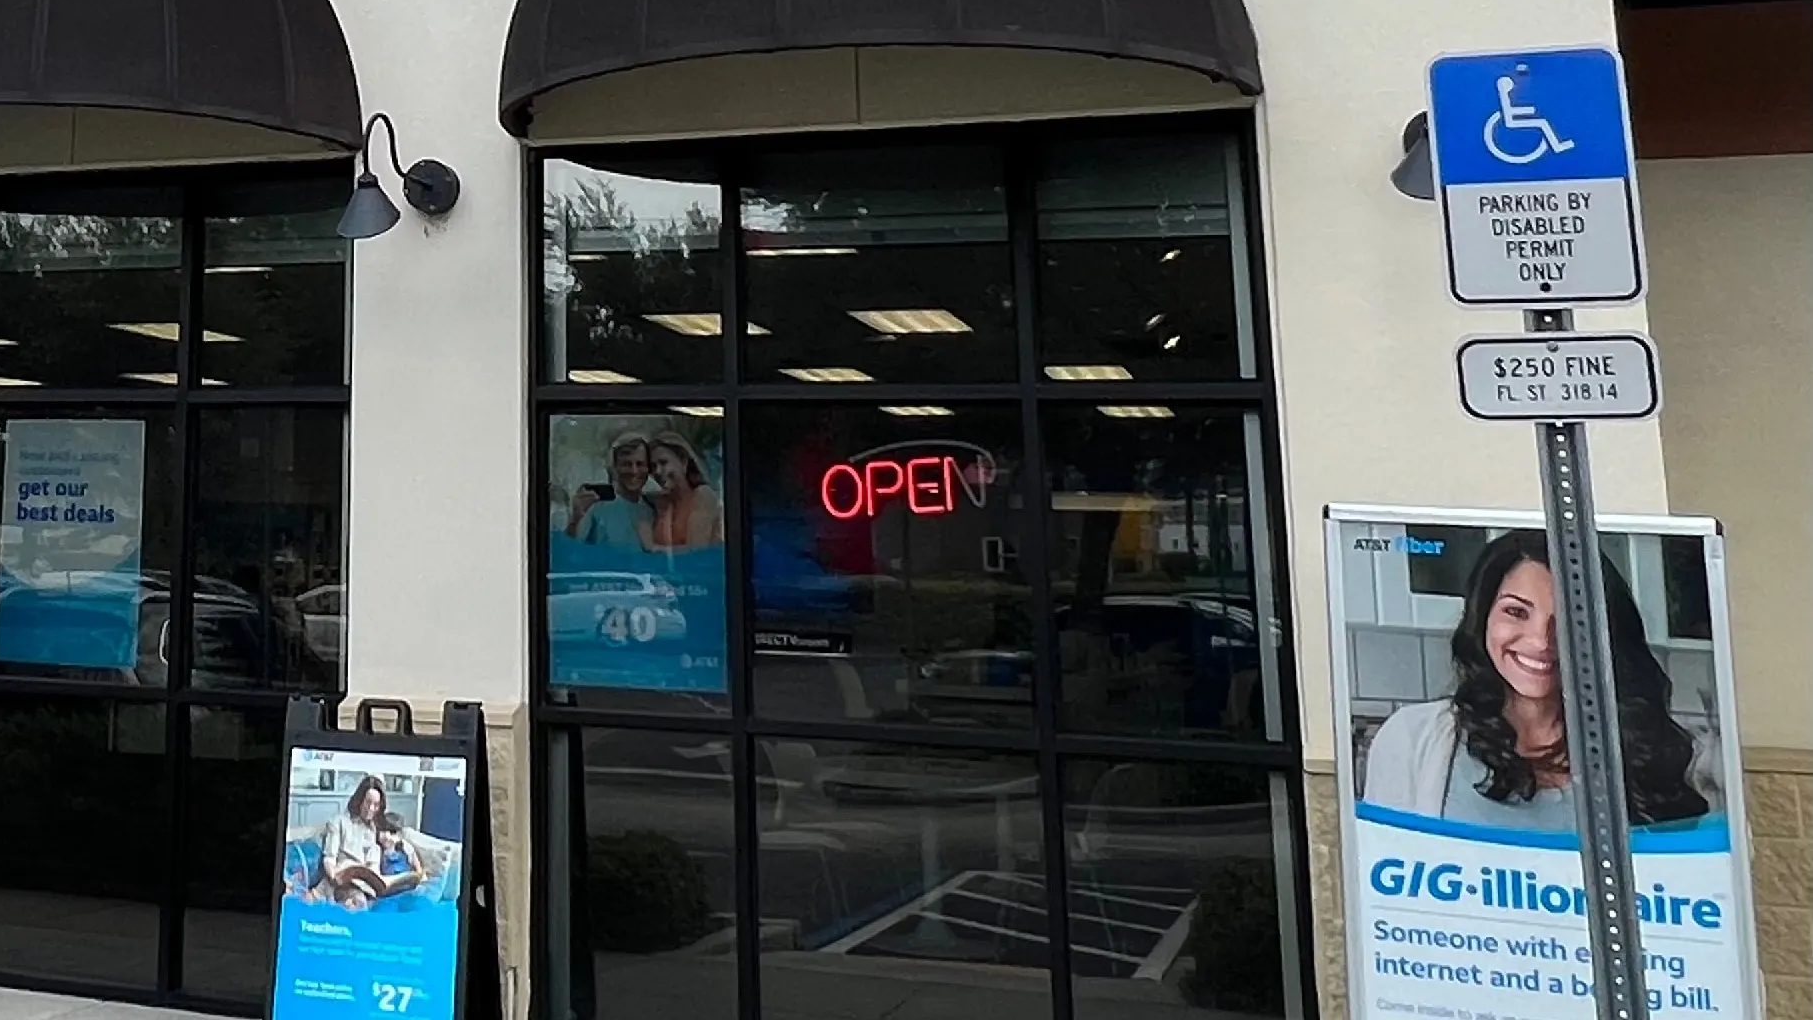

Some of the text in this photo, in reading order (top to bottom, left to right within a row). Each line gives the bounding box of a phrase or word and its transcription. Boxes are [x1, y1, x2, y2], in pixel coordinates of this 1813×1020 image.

[1479, 192, 1592, 215] PARKING BY
[1492, 216, 1585, 236] DISABLED
[1505, 238, 1575, 259] PERMIT
[1519, 261, 1567, 281] ONLY
[1493, 355, 1617, 378] $250 FINE
[18, 480, 89, 500] get our
[821, 455, 986, 519] OPEN
[17, 502, 115, 523] best deals
[1353, 538, 1391, 552] AT&T
[1373, 919, 1498, 952] Someone
[1506, 935, 1568, 962] with
[1374, 952, 1483, 985] internet
[1490, 969, 1540, 992] and
[1548, 977, 1563, 994] a
[1671, 984, 1719, 1013] bill.
